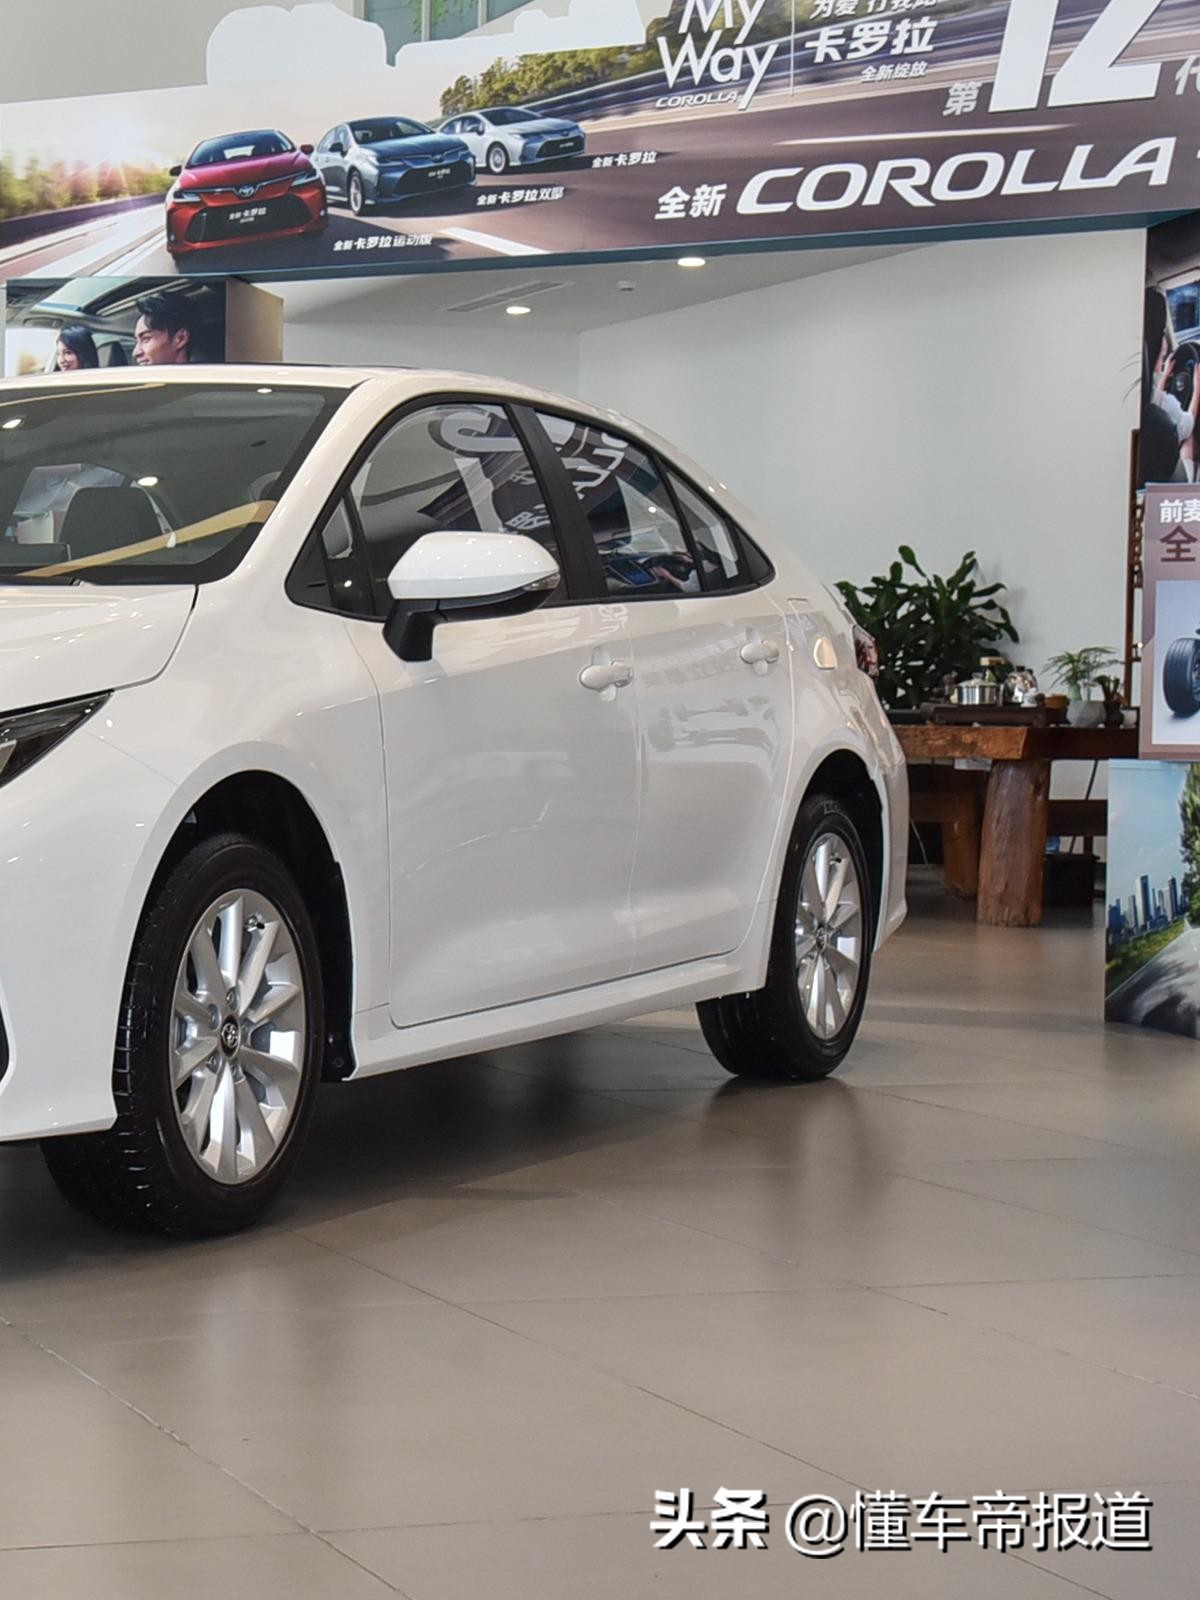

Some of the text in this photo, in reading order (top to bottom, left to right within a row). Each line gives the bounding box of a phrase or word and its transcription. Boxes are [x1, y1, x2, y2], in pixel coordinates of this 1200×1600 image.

[678, 0, 762, 44] My
[805, 16, 939, 63] 卡罗拉
[657, 30, 779, 110] Way
[860, 61, 928, 83] 全新绽放
[655, 91, 739, 108] COROLLA
[655, 137, 1176, 219] 全新 COROLLA
[1160, 525, 1198, 562] 全
